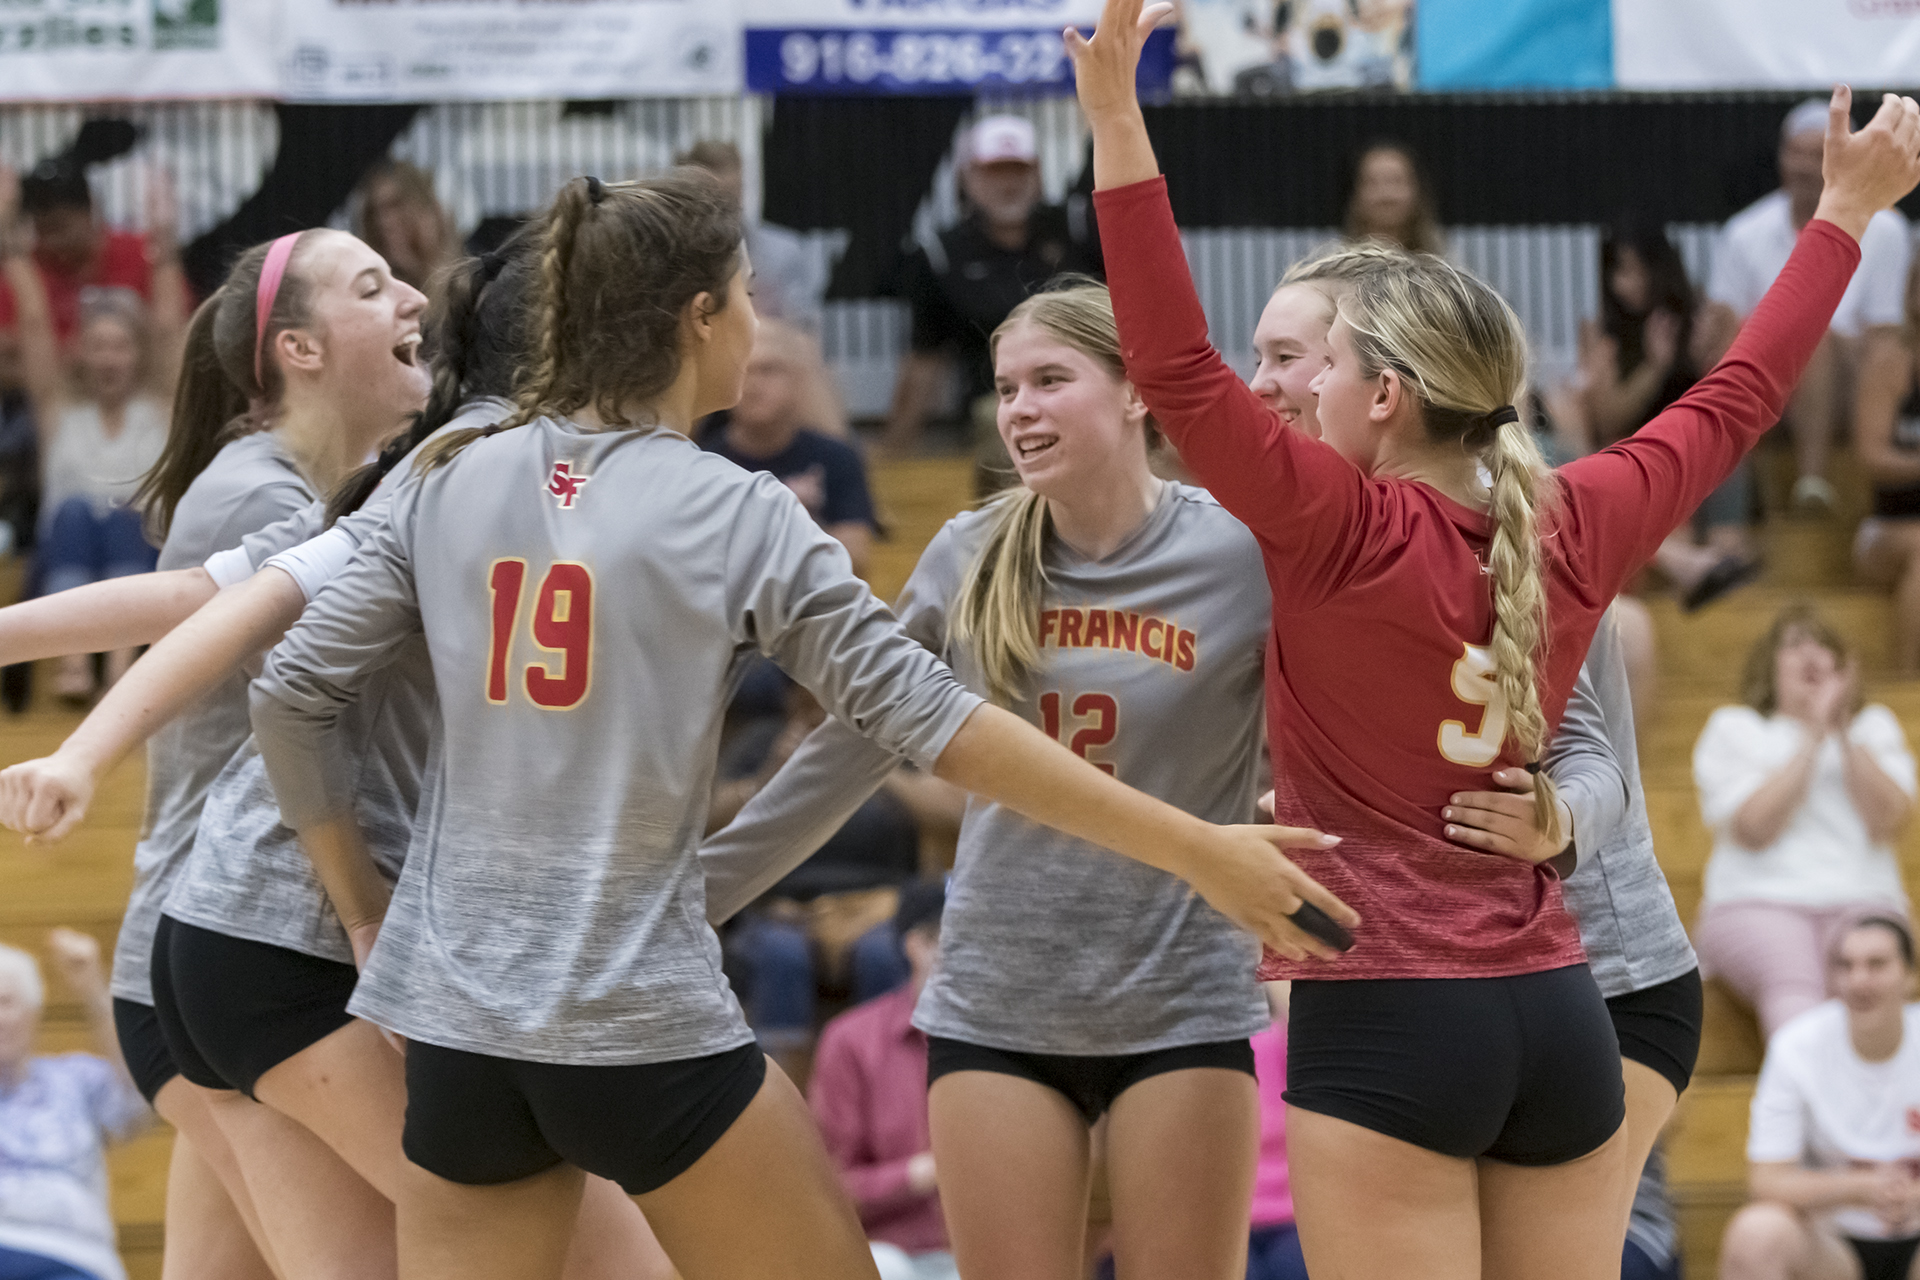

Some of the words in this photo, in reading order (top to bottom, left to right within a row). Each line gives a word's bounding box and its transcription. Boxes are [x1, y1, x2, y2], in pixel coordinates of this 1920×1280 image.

[546, 461, 591, 508] SF
[487, 558, 593, 710] 19
[1038, 608, 1197, 673] FRANCIS
[1038, 691, 1119, 776] 12
